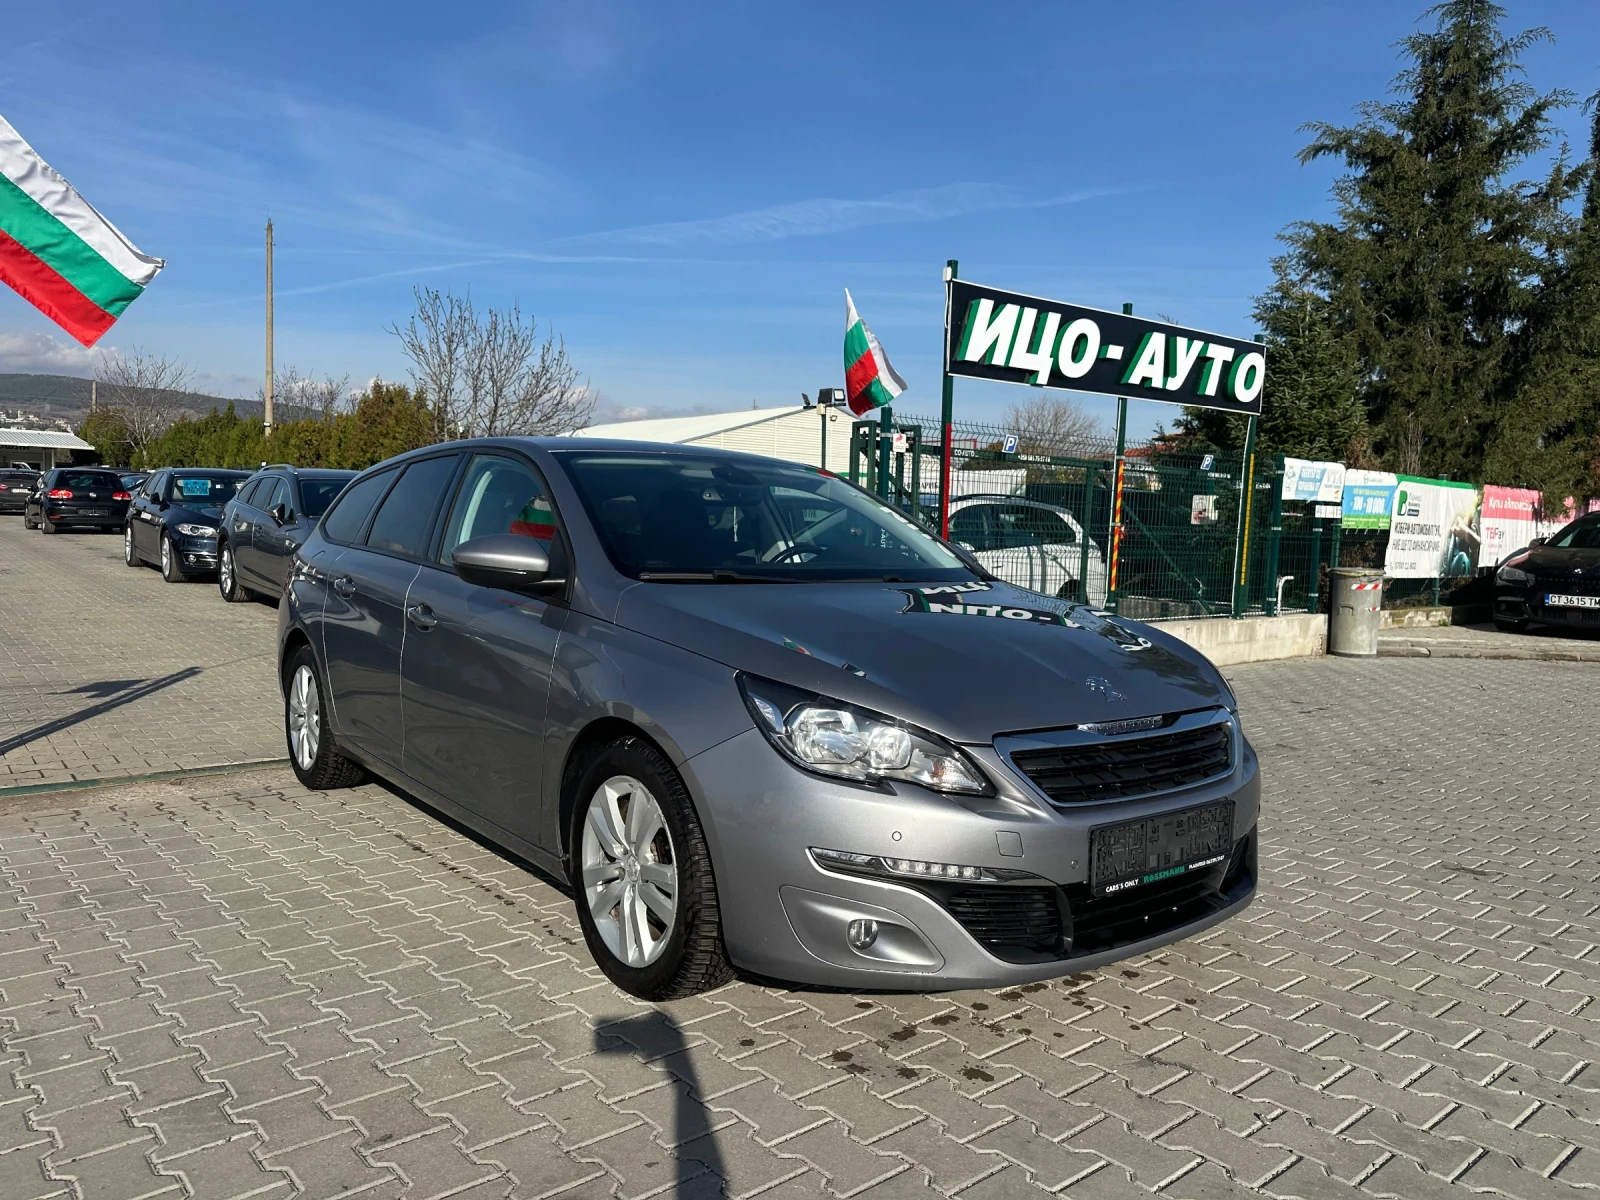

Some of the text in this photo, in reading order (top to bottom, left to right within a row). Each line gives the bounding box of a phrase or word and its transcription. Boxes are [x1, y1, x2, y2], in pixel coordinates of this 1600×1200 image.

[1121, 332, 1266, 403] АУТО
[1550, 595, 1562, 604] CT
[1563, 596, 1586, 606] 3615
[1143, 866, 1185, 883] ROSSMANN
[1124, 878, 1139, 888] ONLY
